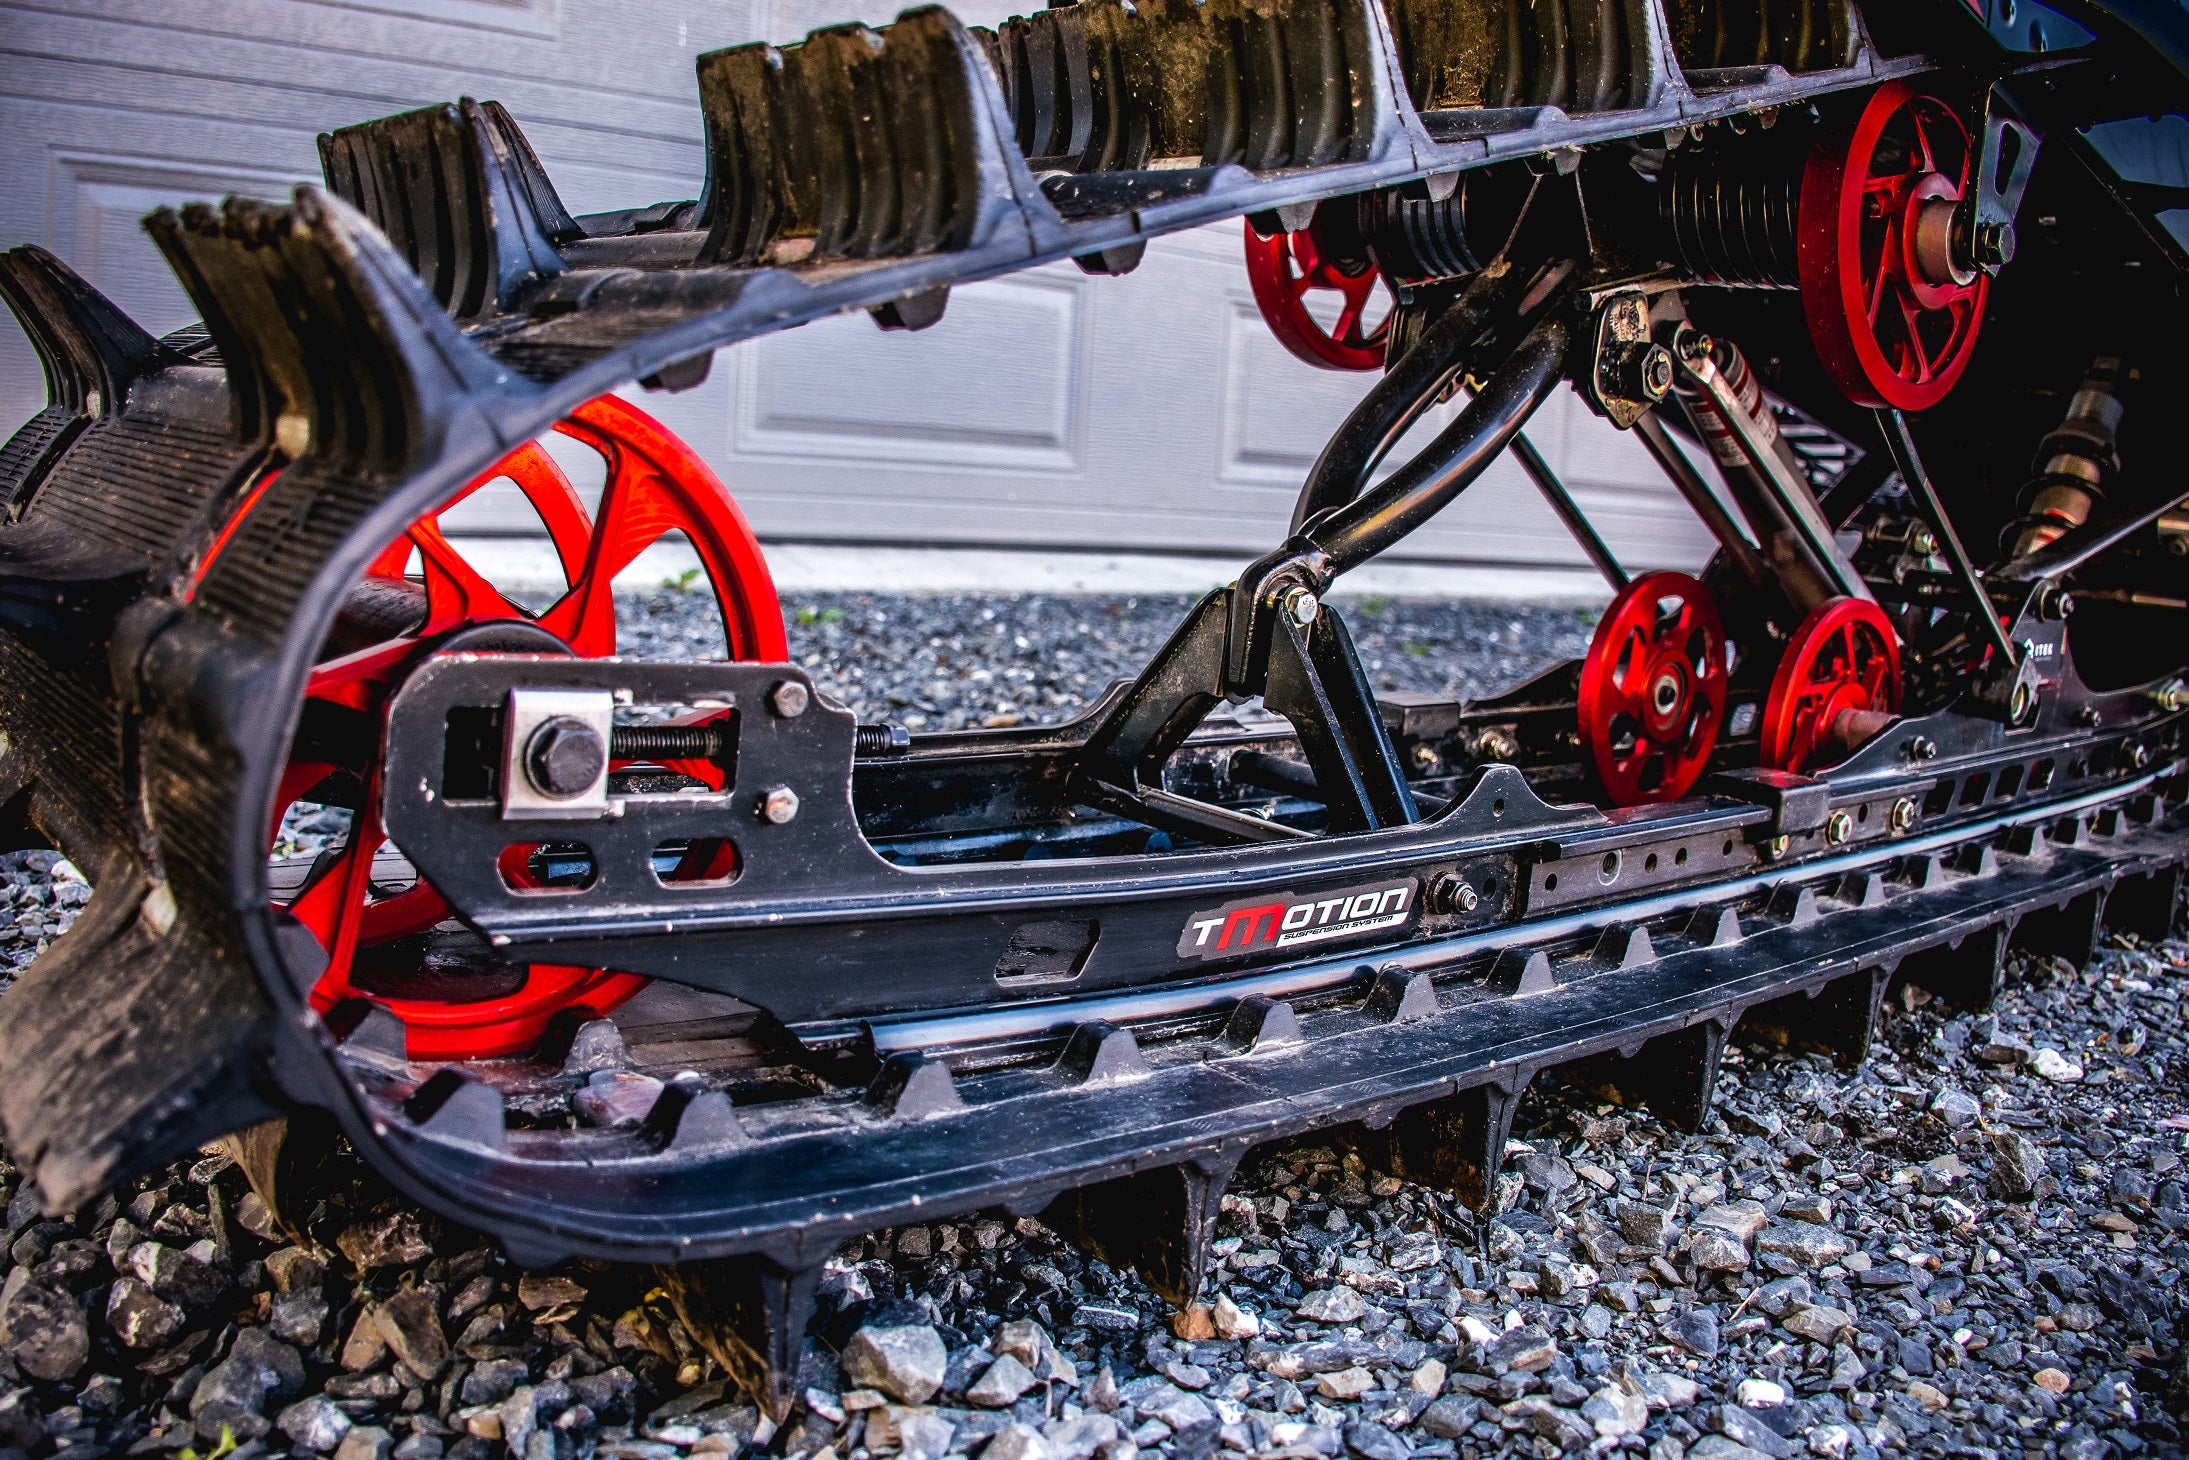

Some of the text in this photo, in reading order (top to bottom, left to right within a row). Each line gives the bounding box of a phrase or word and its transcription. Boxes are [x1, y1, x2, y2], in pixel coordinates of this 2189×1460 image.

[1192, 886, 1409, 950] TMOTION
[1283, 915, 1394, 940] SUSPENSION SYSTEM
